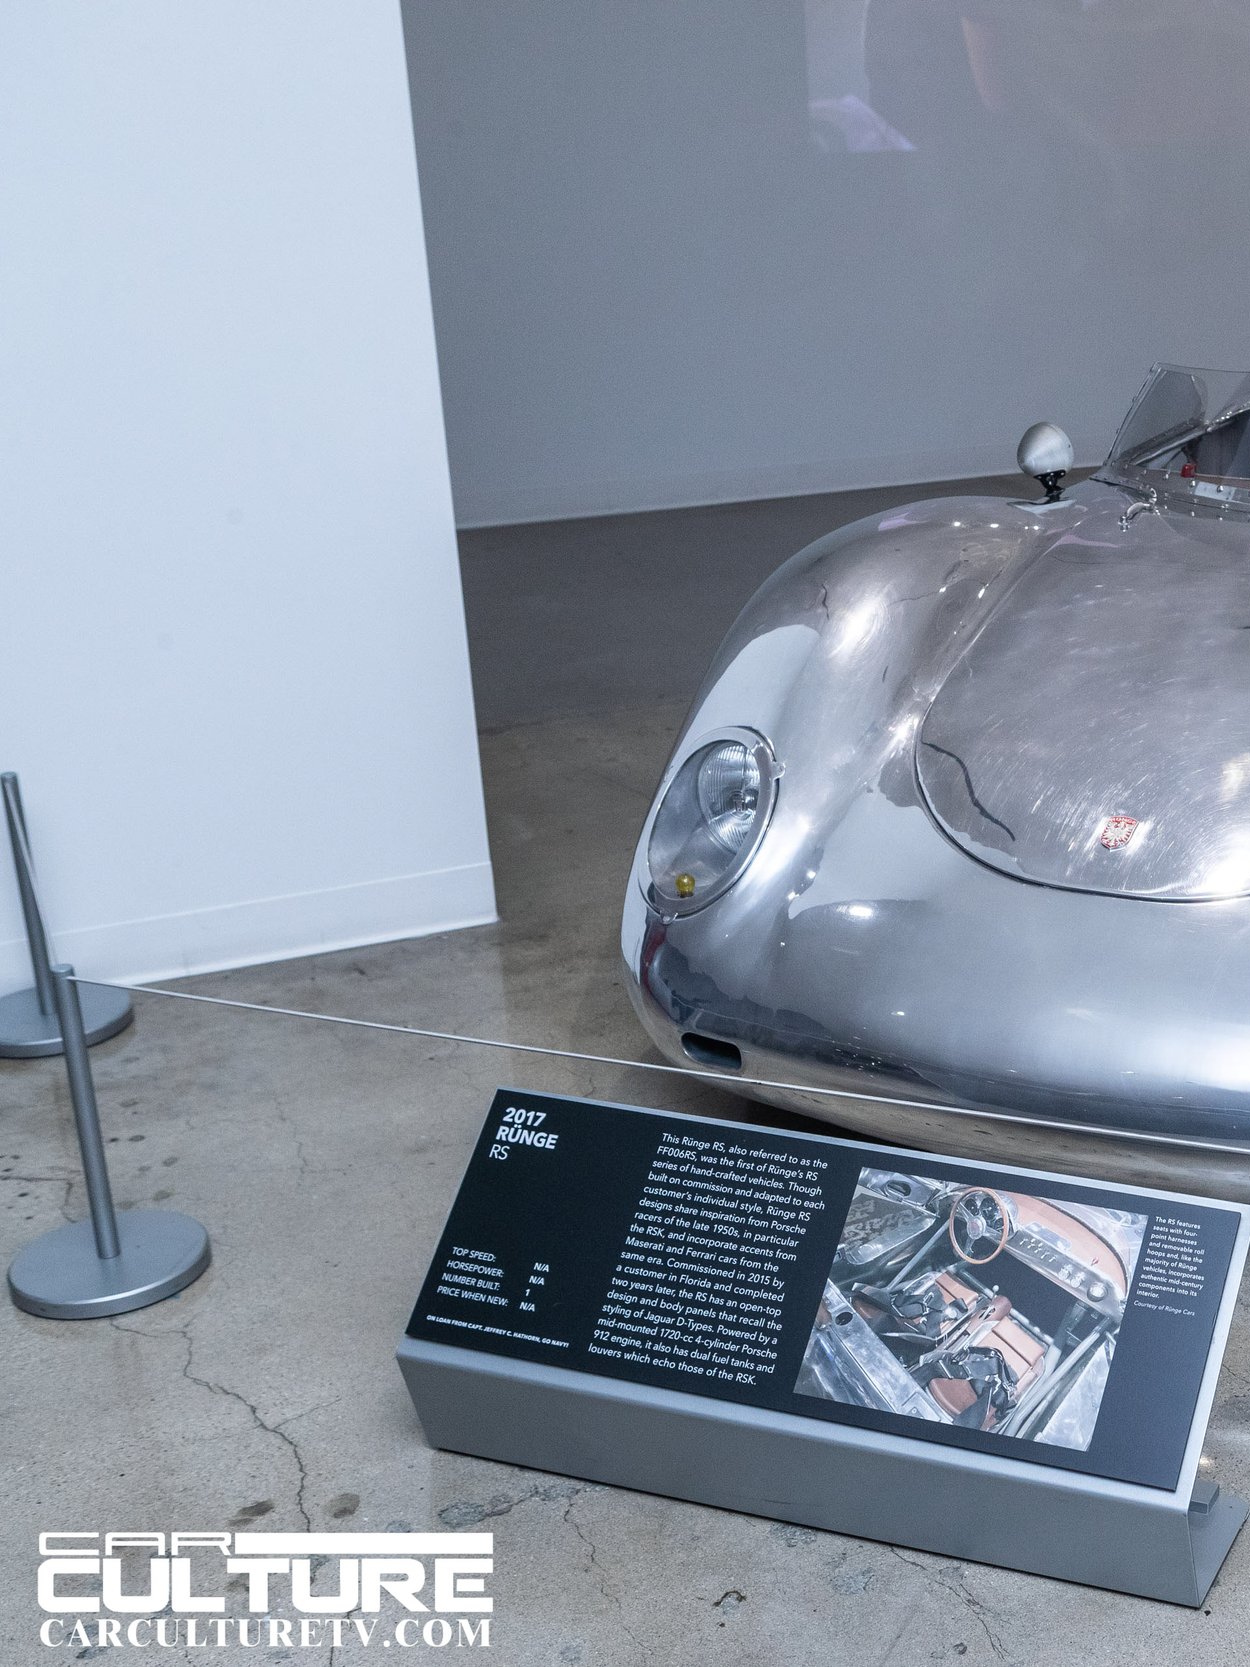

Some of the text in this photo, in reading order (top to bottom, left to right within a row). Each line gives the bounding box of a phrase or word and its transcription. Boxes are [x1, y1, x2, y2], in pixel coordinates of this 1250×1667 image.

[502, 1107, 547, 1127] 2017
[488, 1143, 510, 1160] RS
[495, 1124, 559, 1149] RÜNGE
[662, 1132, 828, 1169] This Rünge RS, also referred to as the
[652, 1160, 822, 1197] series of hand-crafted vehicles. Though
[656, 1145, 697, 1162] FF006RS,
[700, 1155, 718, 1164] was
[719, 1156, 735, 1167] the
[736, 1158, 755, 1170] first
[756, 1163, 768, 1172] of
[805, 1170, 818, 1181] RS
[647, 1170, 668, 1182] built
[682, 1179, 733, 1194] commission
[734, 1188, 753, 1197] and
[753, 1190, 792, 1204] adapted
[792, 1197, 802, 1206] to
[803, 1200, 825, 1210] each
[693, 1192, 739, 1208] individual
[739, 1202, 763, 1214] style,
[766, 1205, 796, 1220] Rünge
[798, 1211, 811, 1222] RS
[634, 1212, 799, 1247] racers of the late 1950s, in particular
[638, 1197, 806, 1235] designs share inspiration from Porsche
[1155, 1216, 1166, 1224] The
[1176, 1219, 1201, 1229] features
[625, 1235, 779, 1272] Maserati and Ferrari cars from the
[630, 1223, 797, 1261] the RSK, and incorporate accents from
[1167, 1235, 1197, 1246] harnesses
[446, 1259, 544, 1285] HORSEPOWER: N/A
[452, 1246, 549, 1272] TOP SPEED: N/A
[620, 1251, 785, 1290] same era. Commissioned in 2015 by
[1168, 1269, 1204, 1281] incorporates
[436, 1285, 535, 1312] PRICE WHEN NEW: N/A
[441, 1272, 530, 1296] NUMBER BUILT: 1
[611, 1276, 782, 1318] two years later, the RS has an open-top
[615, 1264, 785, 1302] a customer in Florida and completed
[1140, 1274, 1204, 1291] authentic mid-century
[601, 1304, 778, 1345] styling of Jaguar D-Types. Powered by a
[606, 1289, 782, 1331] design and body panels that recall the
[435, 1316, 452, 1324] LOAN
[451, 1319, 468, 1327] FROM
[467, 1322, 483, 1331] CAPT.
[483, 1326, 507, 1335] JEFFREY
[512, 1332, 541, 1343] HATHORN,
[551, 1339, 569, 1348] NAVY!
[597, 1317, 778, 1359] mid-mounted 1720-cc 4-cylinder Porsche
[588, 1342, 756, 1385] louvers which echo those of the RSK.
[593, 1329, 775, 1374] 912 engine, it also has dual fuel tanks and
